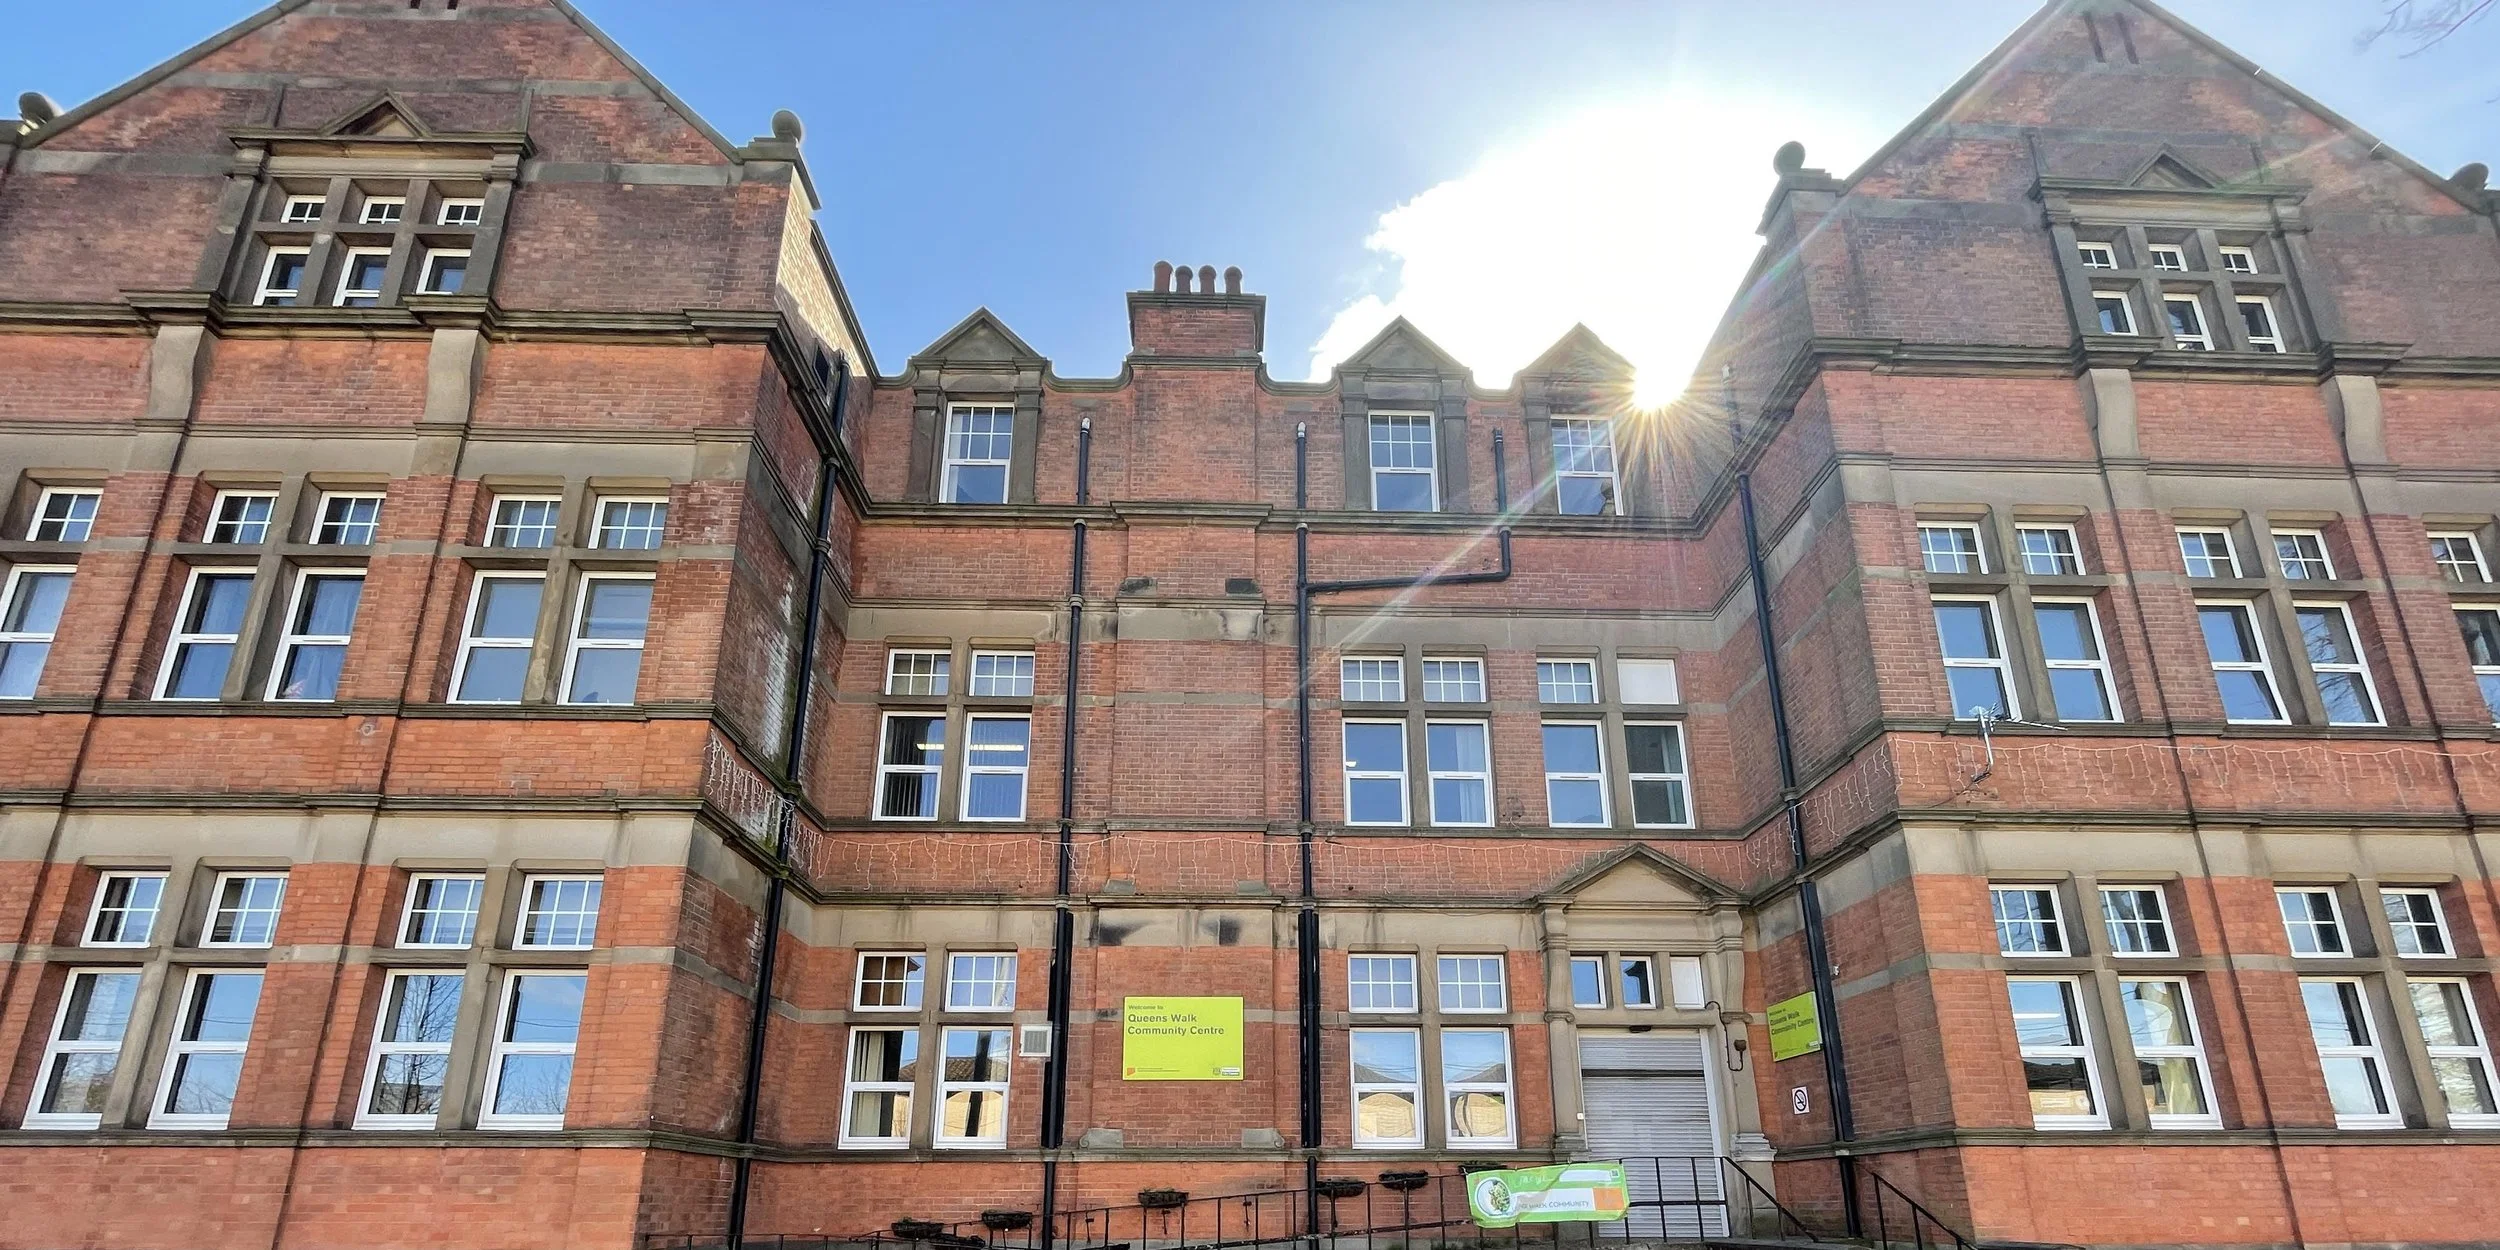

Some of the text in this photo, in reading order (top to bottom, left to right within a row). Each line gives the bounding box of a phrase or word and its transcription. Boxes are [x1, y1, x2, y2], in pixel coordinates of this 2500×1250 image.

[1128, 1014, 1197, 1022] Queens Walk
[1128, 1026, 1224, 1035] Community Centre
[1548, 1200, 1589, 1208] COMMUNITY
